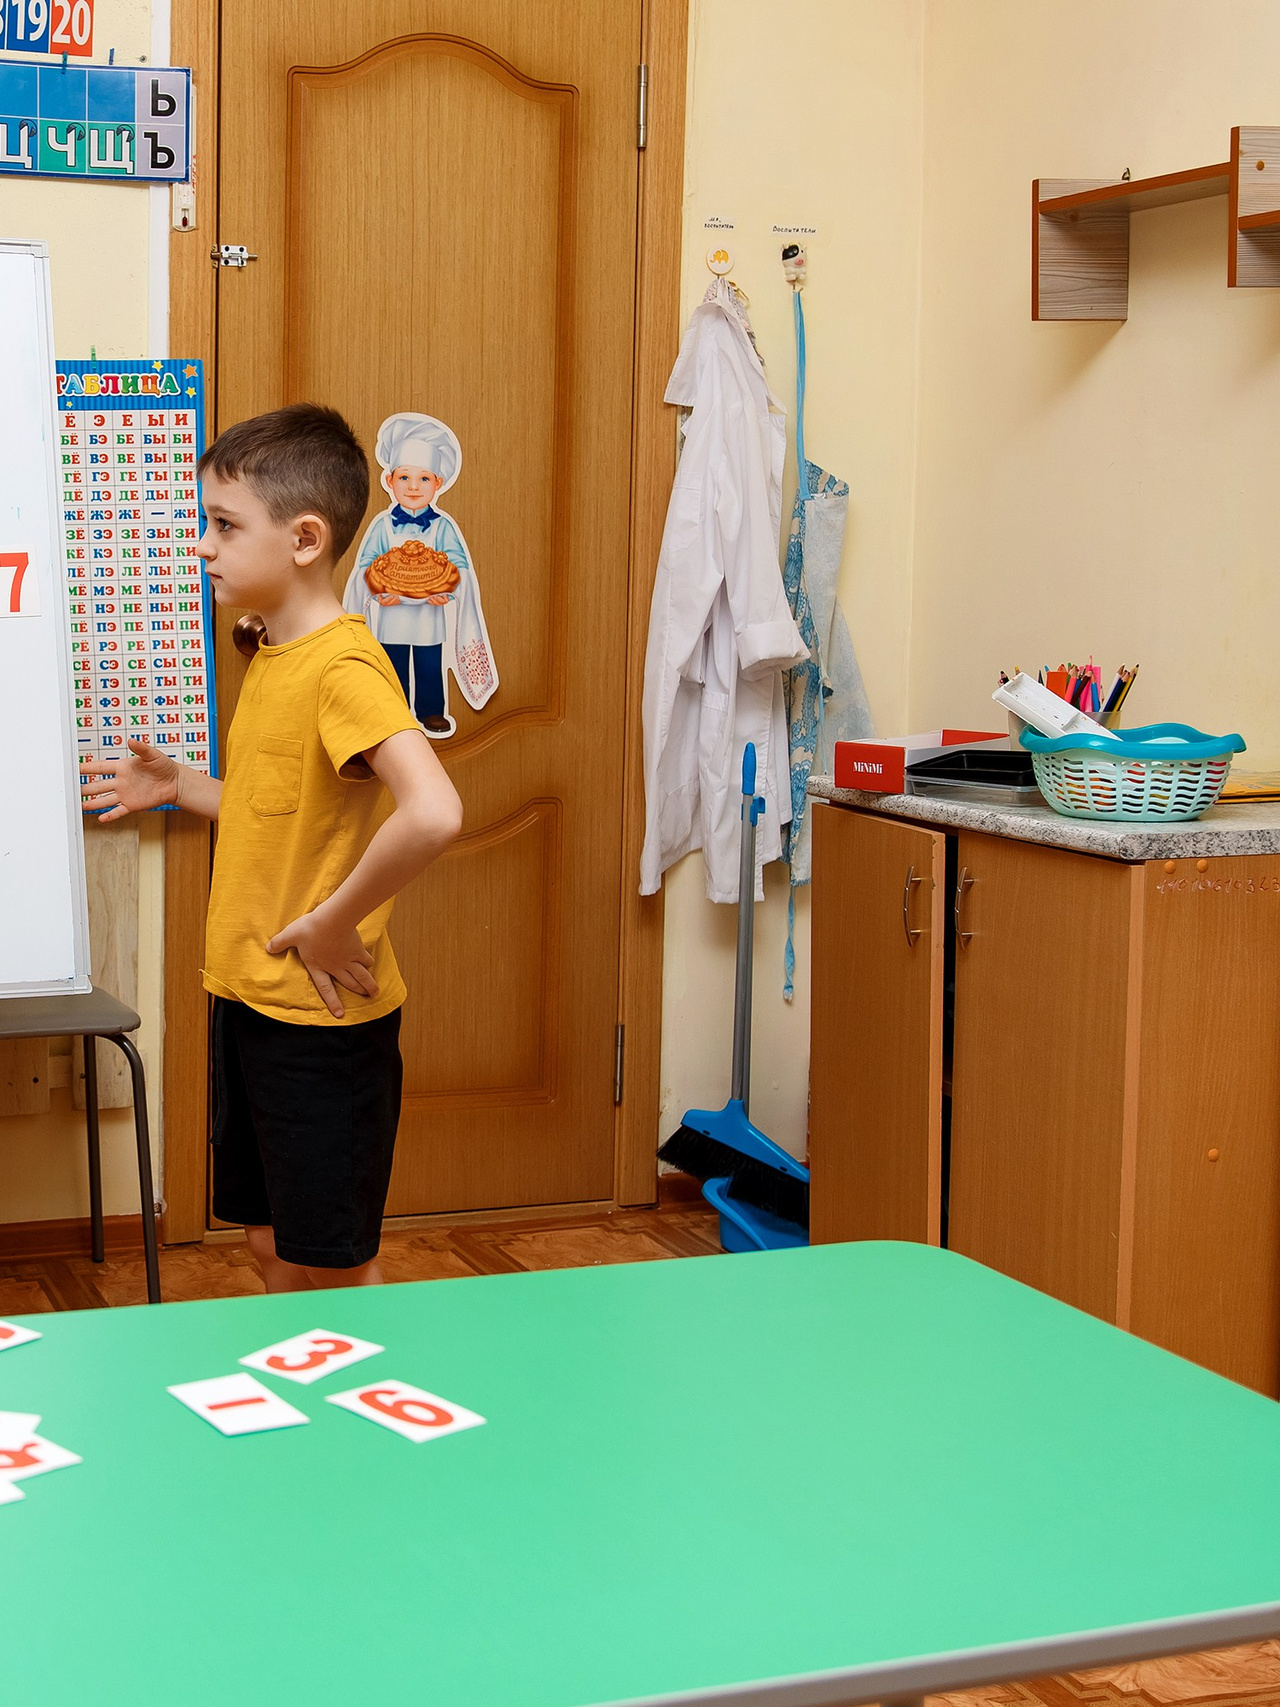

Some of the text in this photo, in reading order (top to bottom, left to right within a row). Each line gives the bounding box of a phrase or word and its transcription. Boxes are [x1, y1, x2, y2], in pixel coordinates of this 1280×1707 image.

[11, 0, 47, 41] 19
[52, 0, 92, 46] 20
[150, 78, 177, 118] Ь
[0, 124, 34, 168] Ц
[48, 127, 78, 167] Ч
[90, 129, 136, 174] Щ
[144, 132, 175, 168] Ъ
[56, 374, 180, 396] ТАБЛИЦА
[65, 413, 188, 428] Ё Э Е Ы И
[61, 432, 193, 446] БЁ БЭ БЕ БЫ БИ
[62, 452, 194, 465] ВЁ ВЭ ВЕ ВЫ ВИ
[64, 470, 193, 483] ГЁ ГЭ ГЕ ГЫ ГИ
[64, 488, 195, 502] ДЁ ДЭ ДЕ ДЫ ДИ
[64, 508, 197, 521] ЖЁ ЖЭ ЖЕ ЖИ
[66, 527, 196, 540] ЗЁ ЗЭ ЗЕ ЗЫ ЗИ
[67, 546, 197, 559] КЁ КЭ КЕ КЫ КИ
[94, 567, 115, 577] ЛЭ
[122, 566, 142, 577] ЛЕ
[149, 565, 171, 576] ЛЫ
[176, 565, 198, 576] ЛИ
[94, 585, 115, 596] МЭ
[122, 585, 142, 596] МЕ
[149, 583, 173, 595] МЫ
[178, 583, 200, 594] МИ
[95, 603, 116, 614] НЭ
[124, 603, 143, 613] НЕ
[150, 602, 174, 613] НЫ
[179, 601, 200, 612] НИ
[97, 622, 117, 632] ПЭ
[124, 621, 144, 632] ПЕ
[152, 620, 174, 631] ПЫ
[180, 620, 200, 631] ПИ
[72, 638, 201, 653] РЁ РЭ РЕ РЫ РИ
[73, 657, 203, 672] СЁ СЭ СЕ СЫ СИ
[100, 677, 120, 689] ТЭ
[128, 677, 147, 688] ТЕ
[155, 676, 178, 687] ТЫ
[183, 675, 203, 686] ТИ
[99, 696, 121, 708] ФЭ
[128, 695, 148, 707] ФЕ
[154, 695, 179, 706] ФЫ
[183, 694, 205, 705] ФИ
[102, 712, 206, 727] ХЭ ХЕ ХЫ ХИ
[102, 735, 123, 747] ЦЭ
[156, 733, 181, 745] ЦЫ
[186, 731, 207, 744] ЦИ
[186, 750, 207, 761] ЧИ
[266, 1339, 354, 1372] 3
